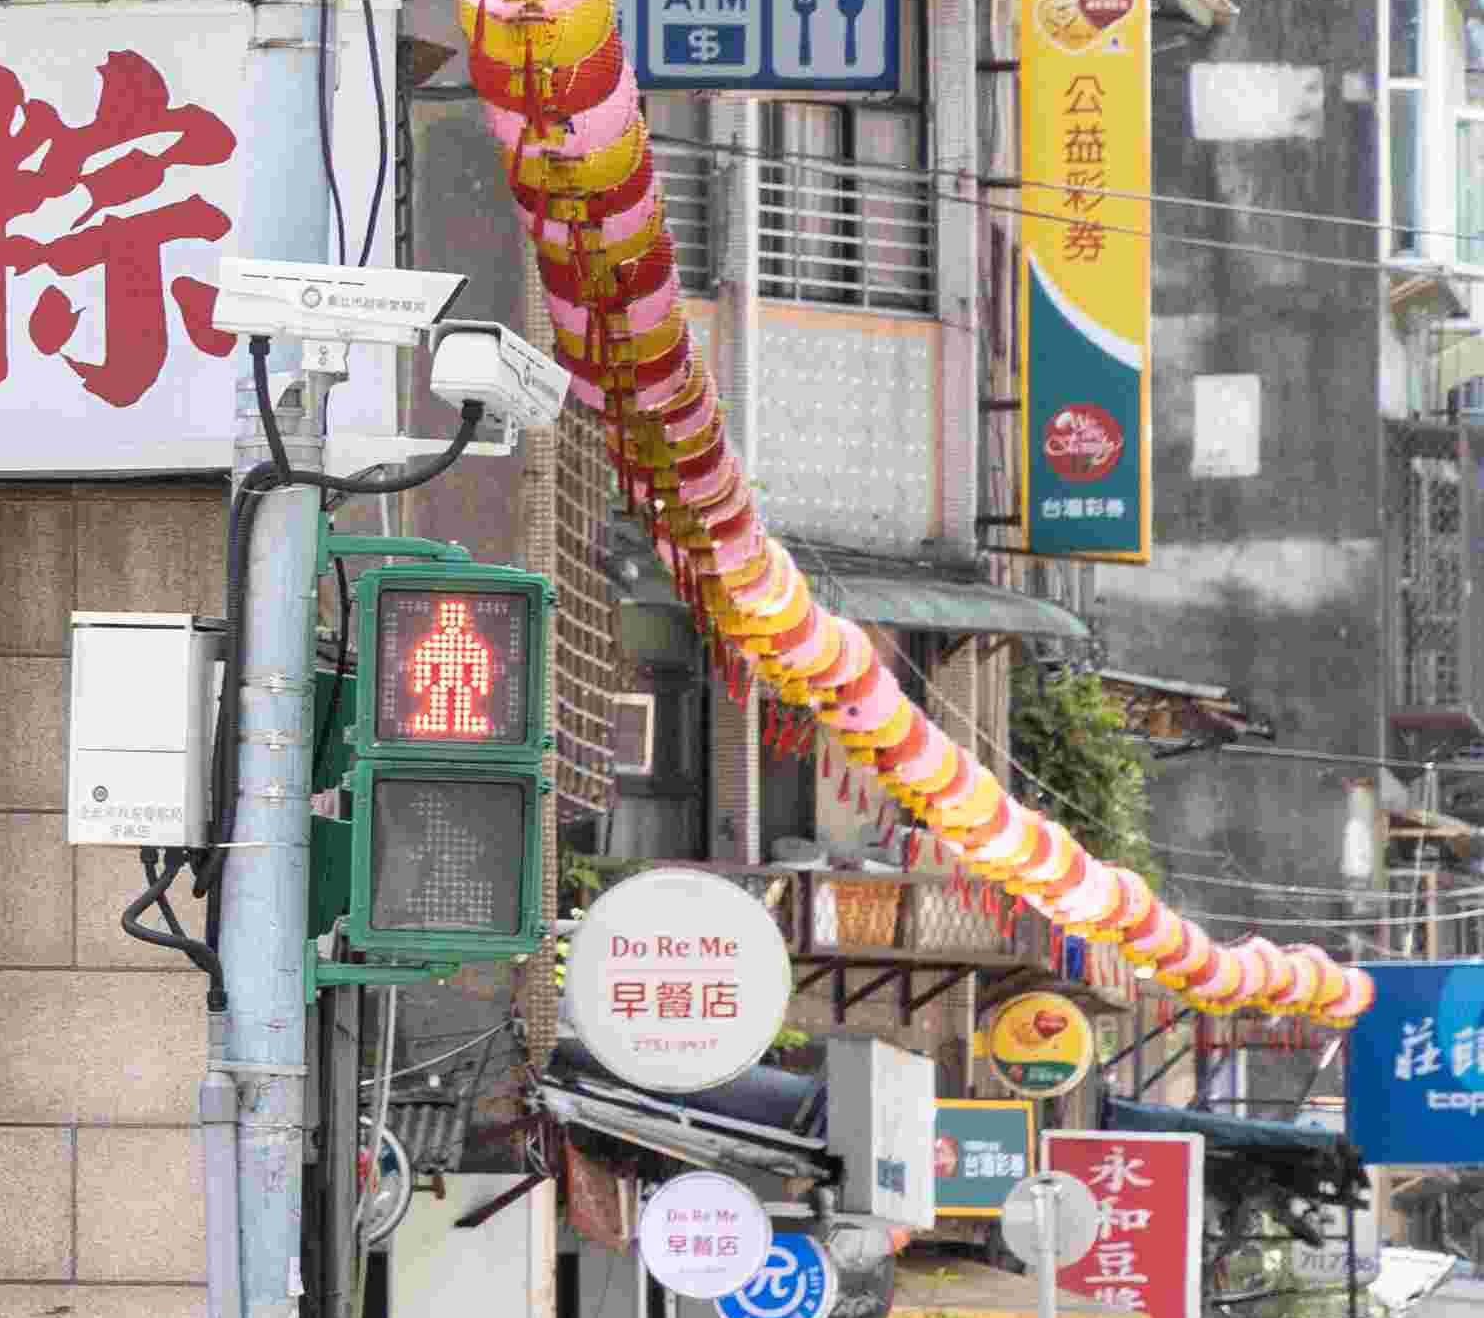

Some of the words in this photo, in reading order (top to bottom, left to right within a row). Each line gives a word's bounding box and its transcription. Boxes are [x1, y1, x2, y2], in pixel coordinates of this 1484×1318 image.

[1062, 72, 1107, 263] 公益彩券
[611, 936, 647, 958] Do
[657, 936, 690, 958] Re
[700, 936, 738, 958] Me
[611, 980, 739, 1020] 早餐店
